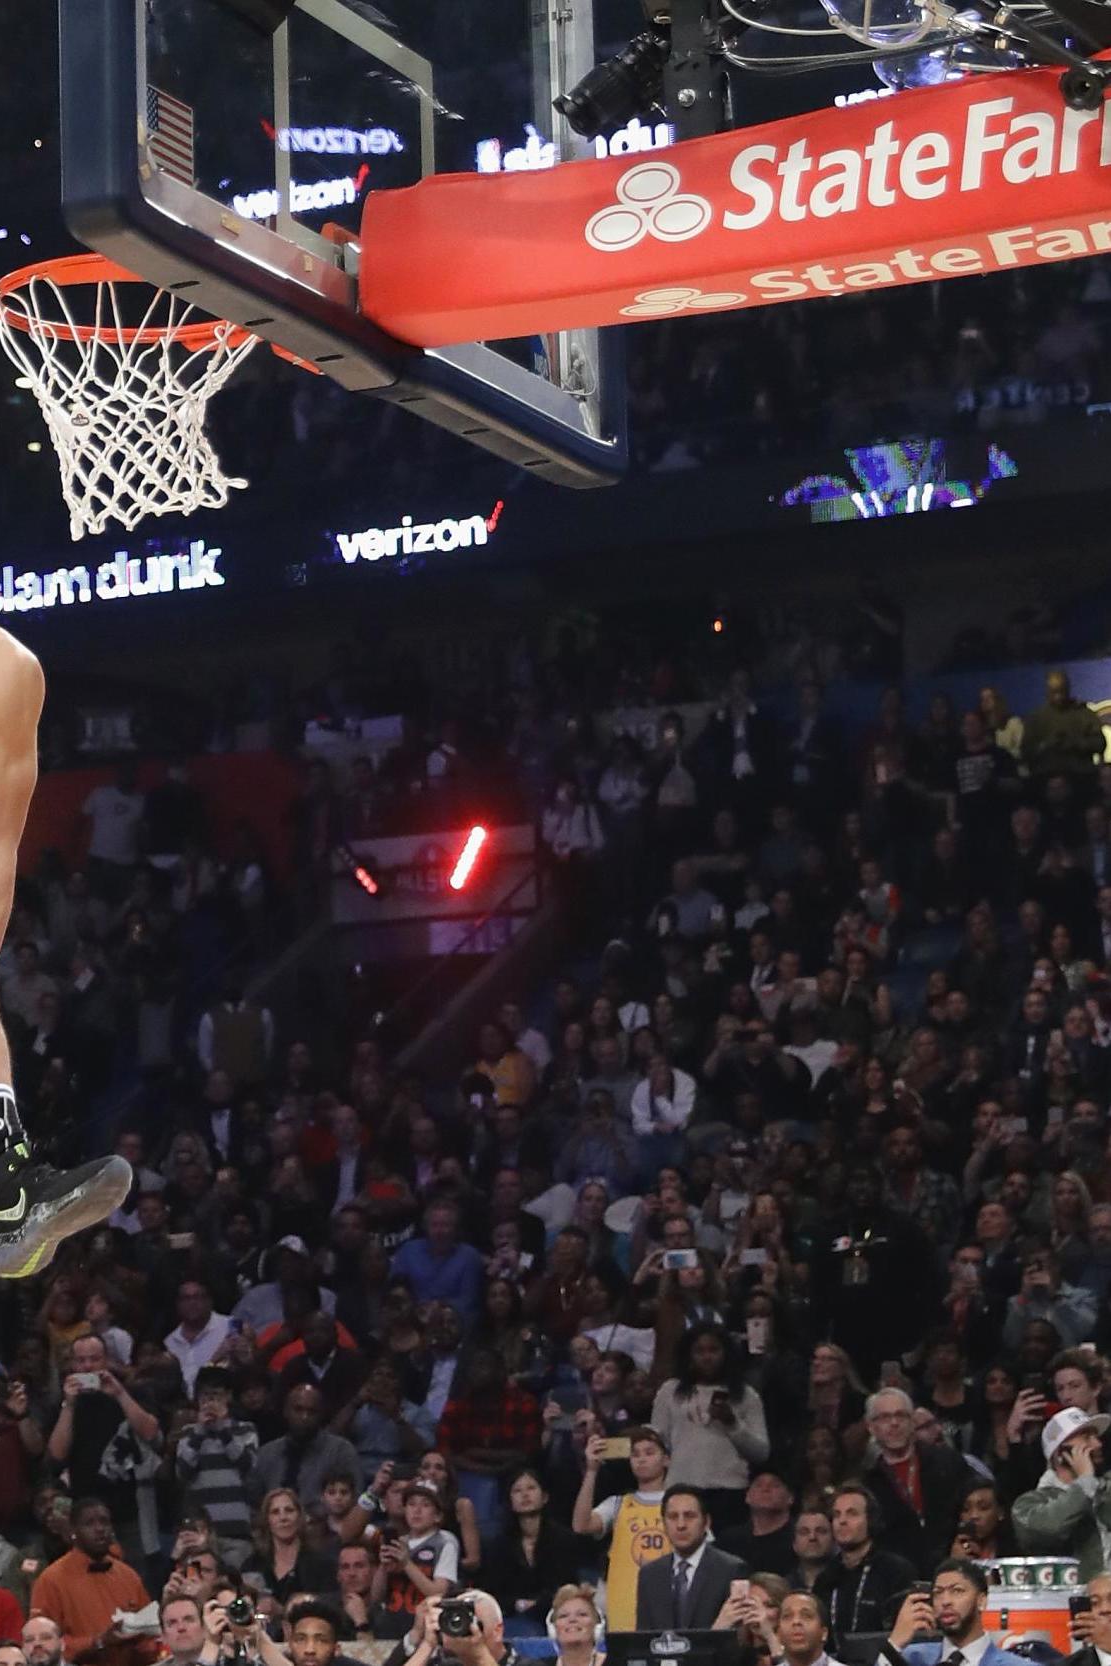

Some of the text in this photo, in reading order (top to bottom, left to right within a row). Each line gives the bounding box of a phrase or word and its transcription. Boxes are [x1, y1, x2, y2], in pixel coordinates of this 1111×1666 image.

[960, 97, 1111, 191] Far
[336, 515, 488, 563] verizon
[96, 540, 225, 600] dunk
[641, 1535, 663, 1550] 30
